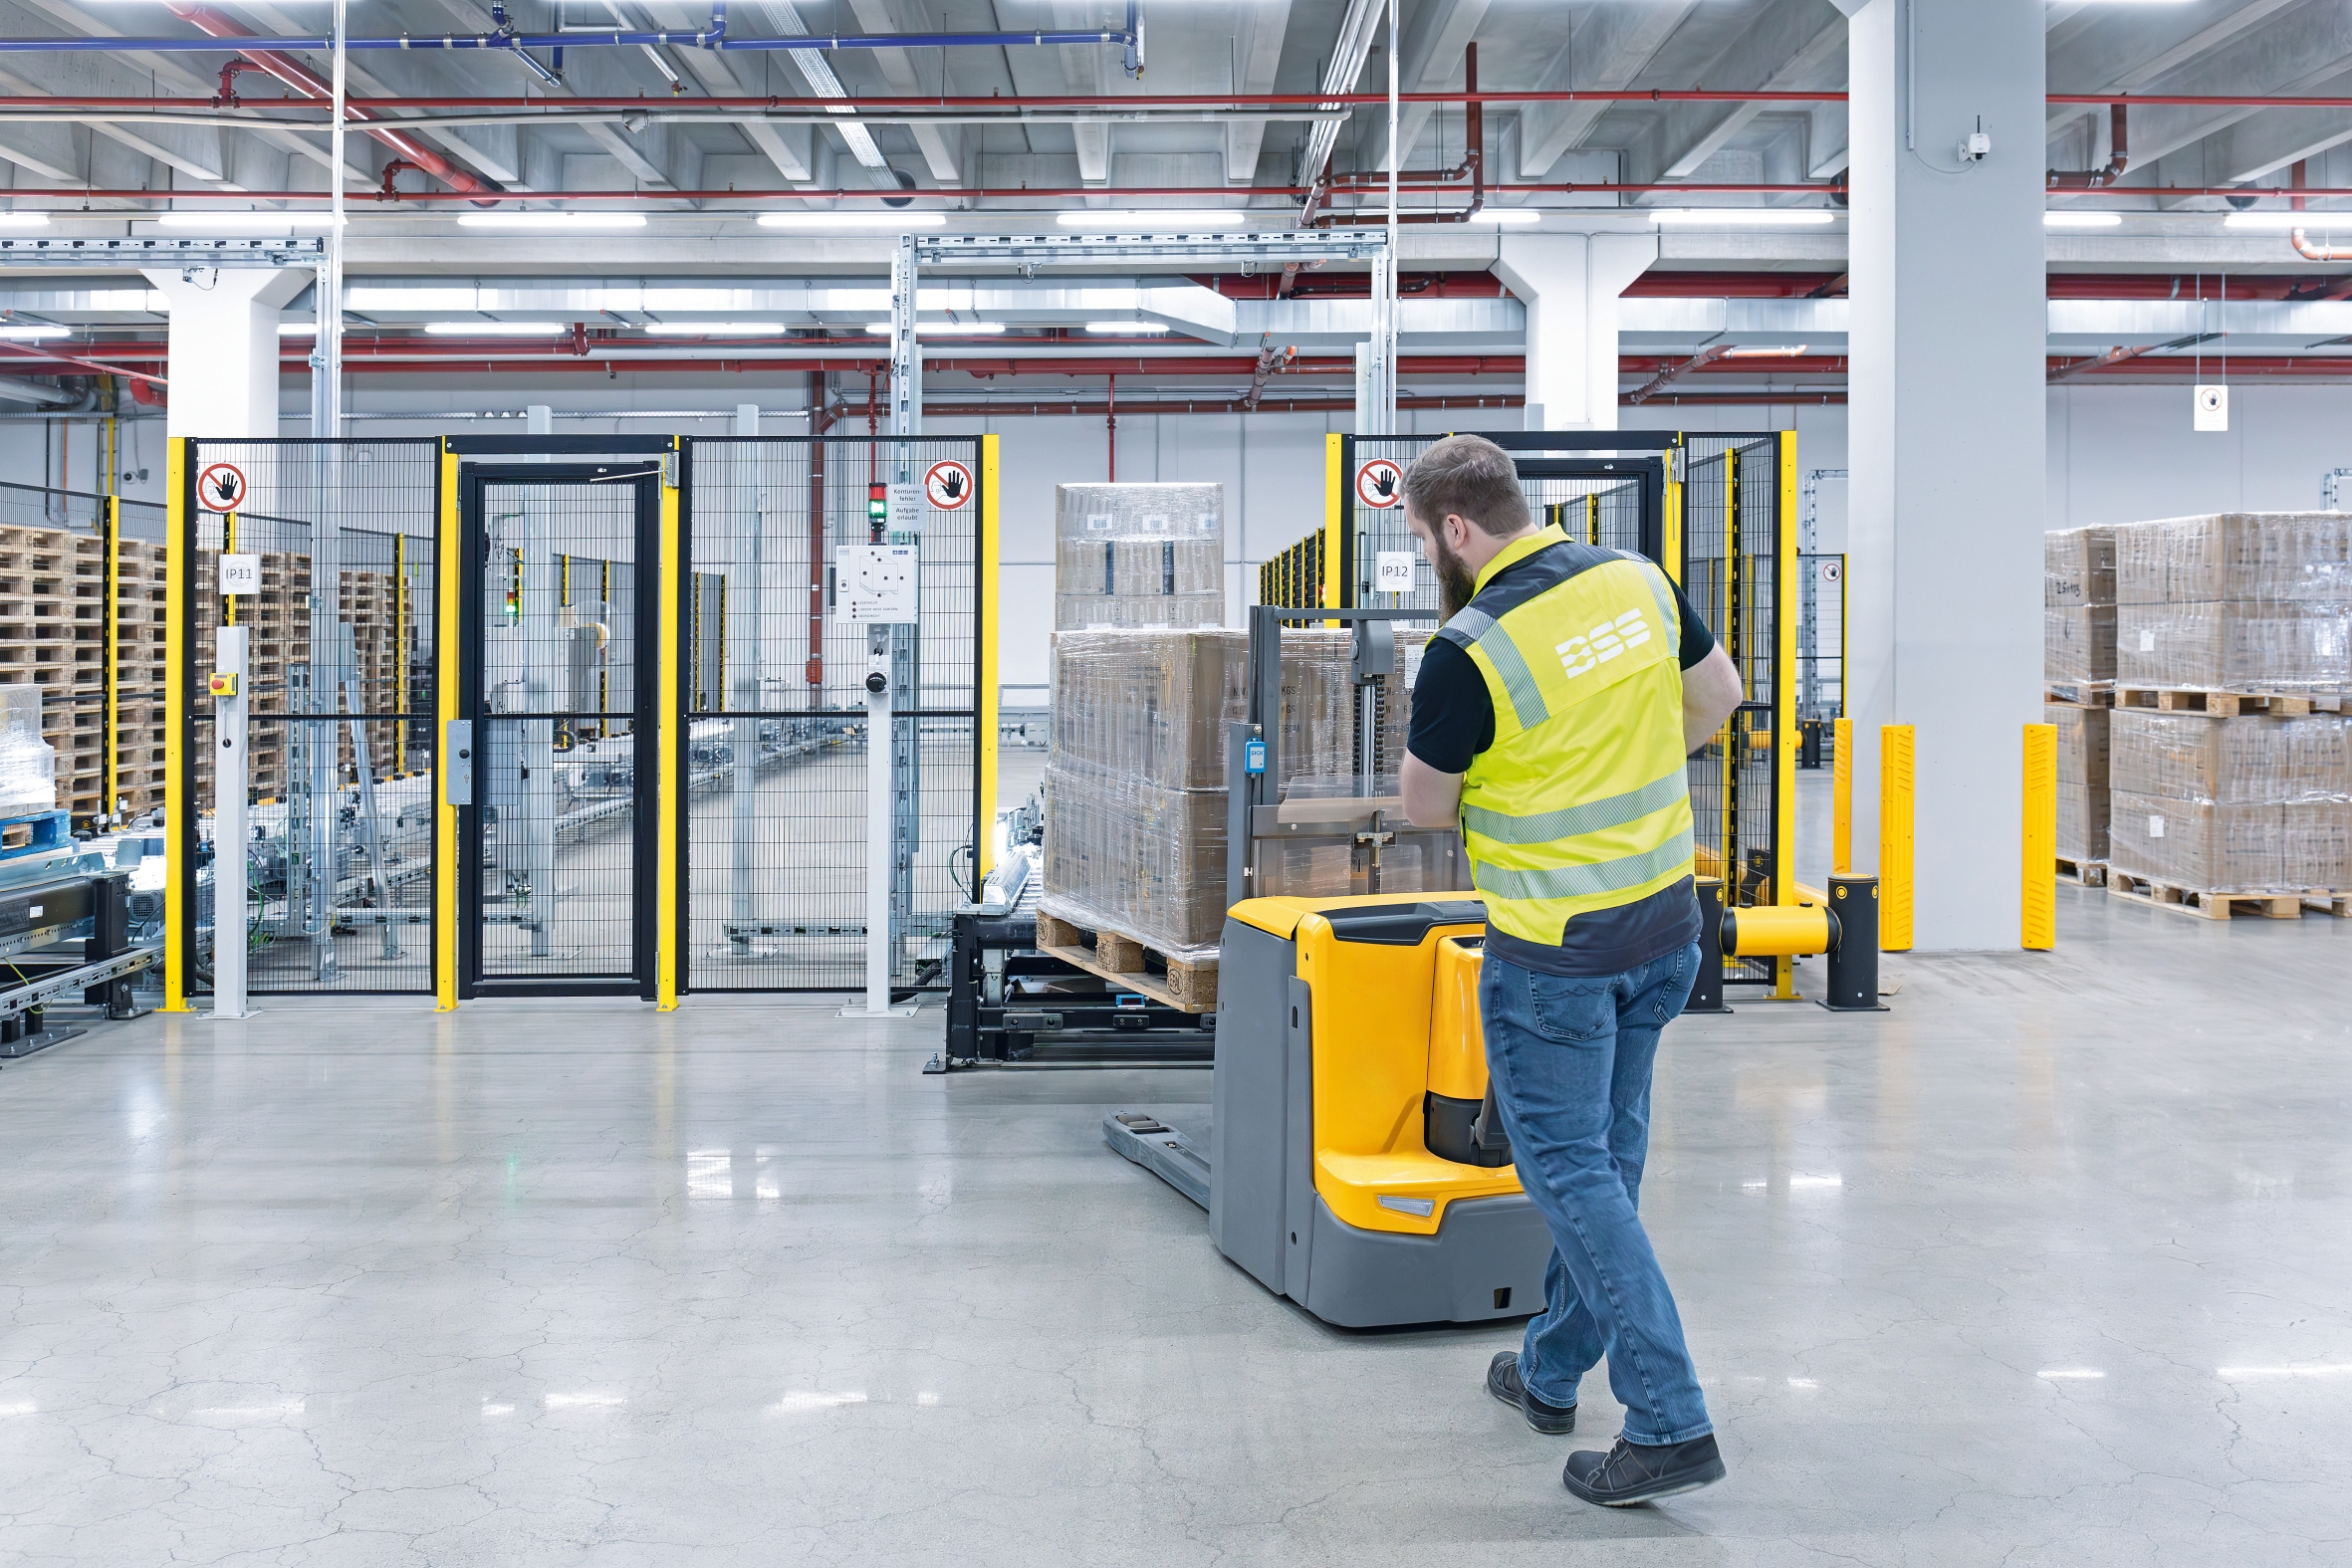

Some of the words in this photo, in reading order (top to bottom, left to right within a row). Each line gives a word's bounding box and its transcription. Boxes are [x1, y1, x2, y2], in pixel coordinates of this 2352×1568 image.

[226, 568, 253, 579] IP11
[1381, 565, 1408, 577] IP12
[1281, 685, 1296, 697] KGS
